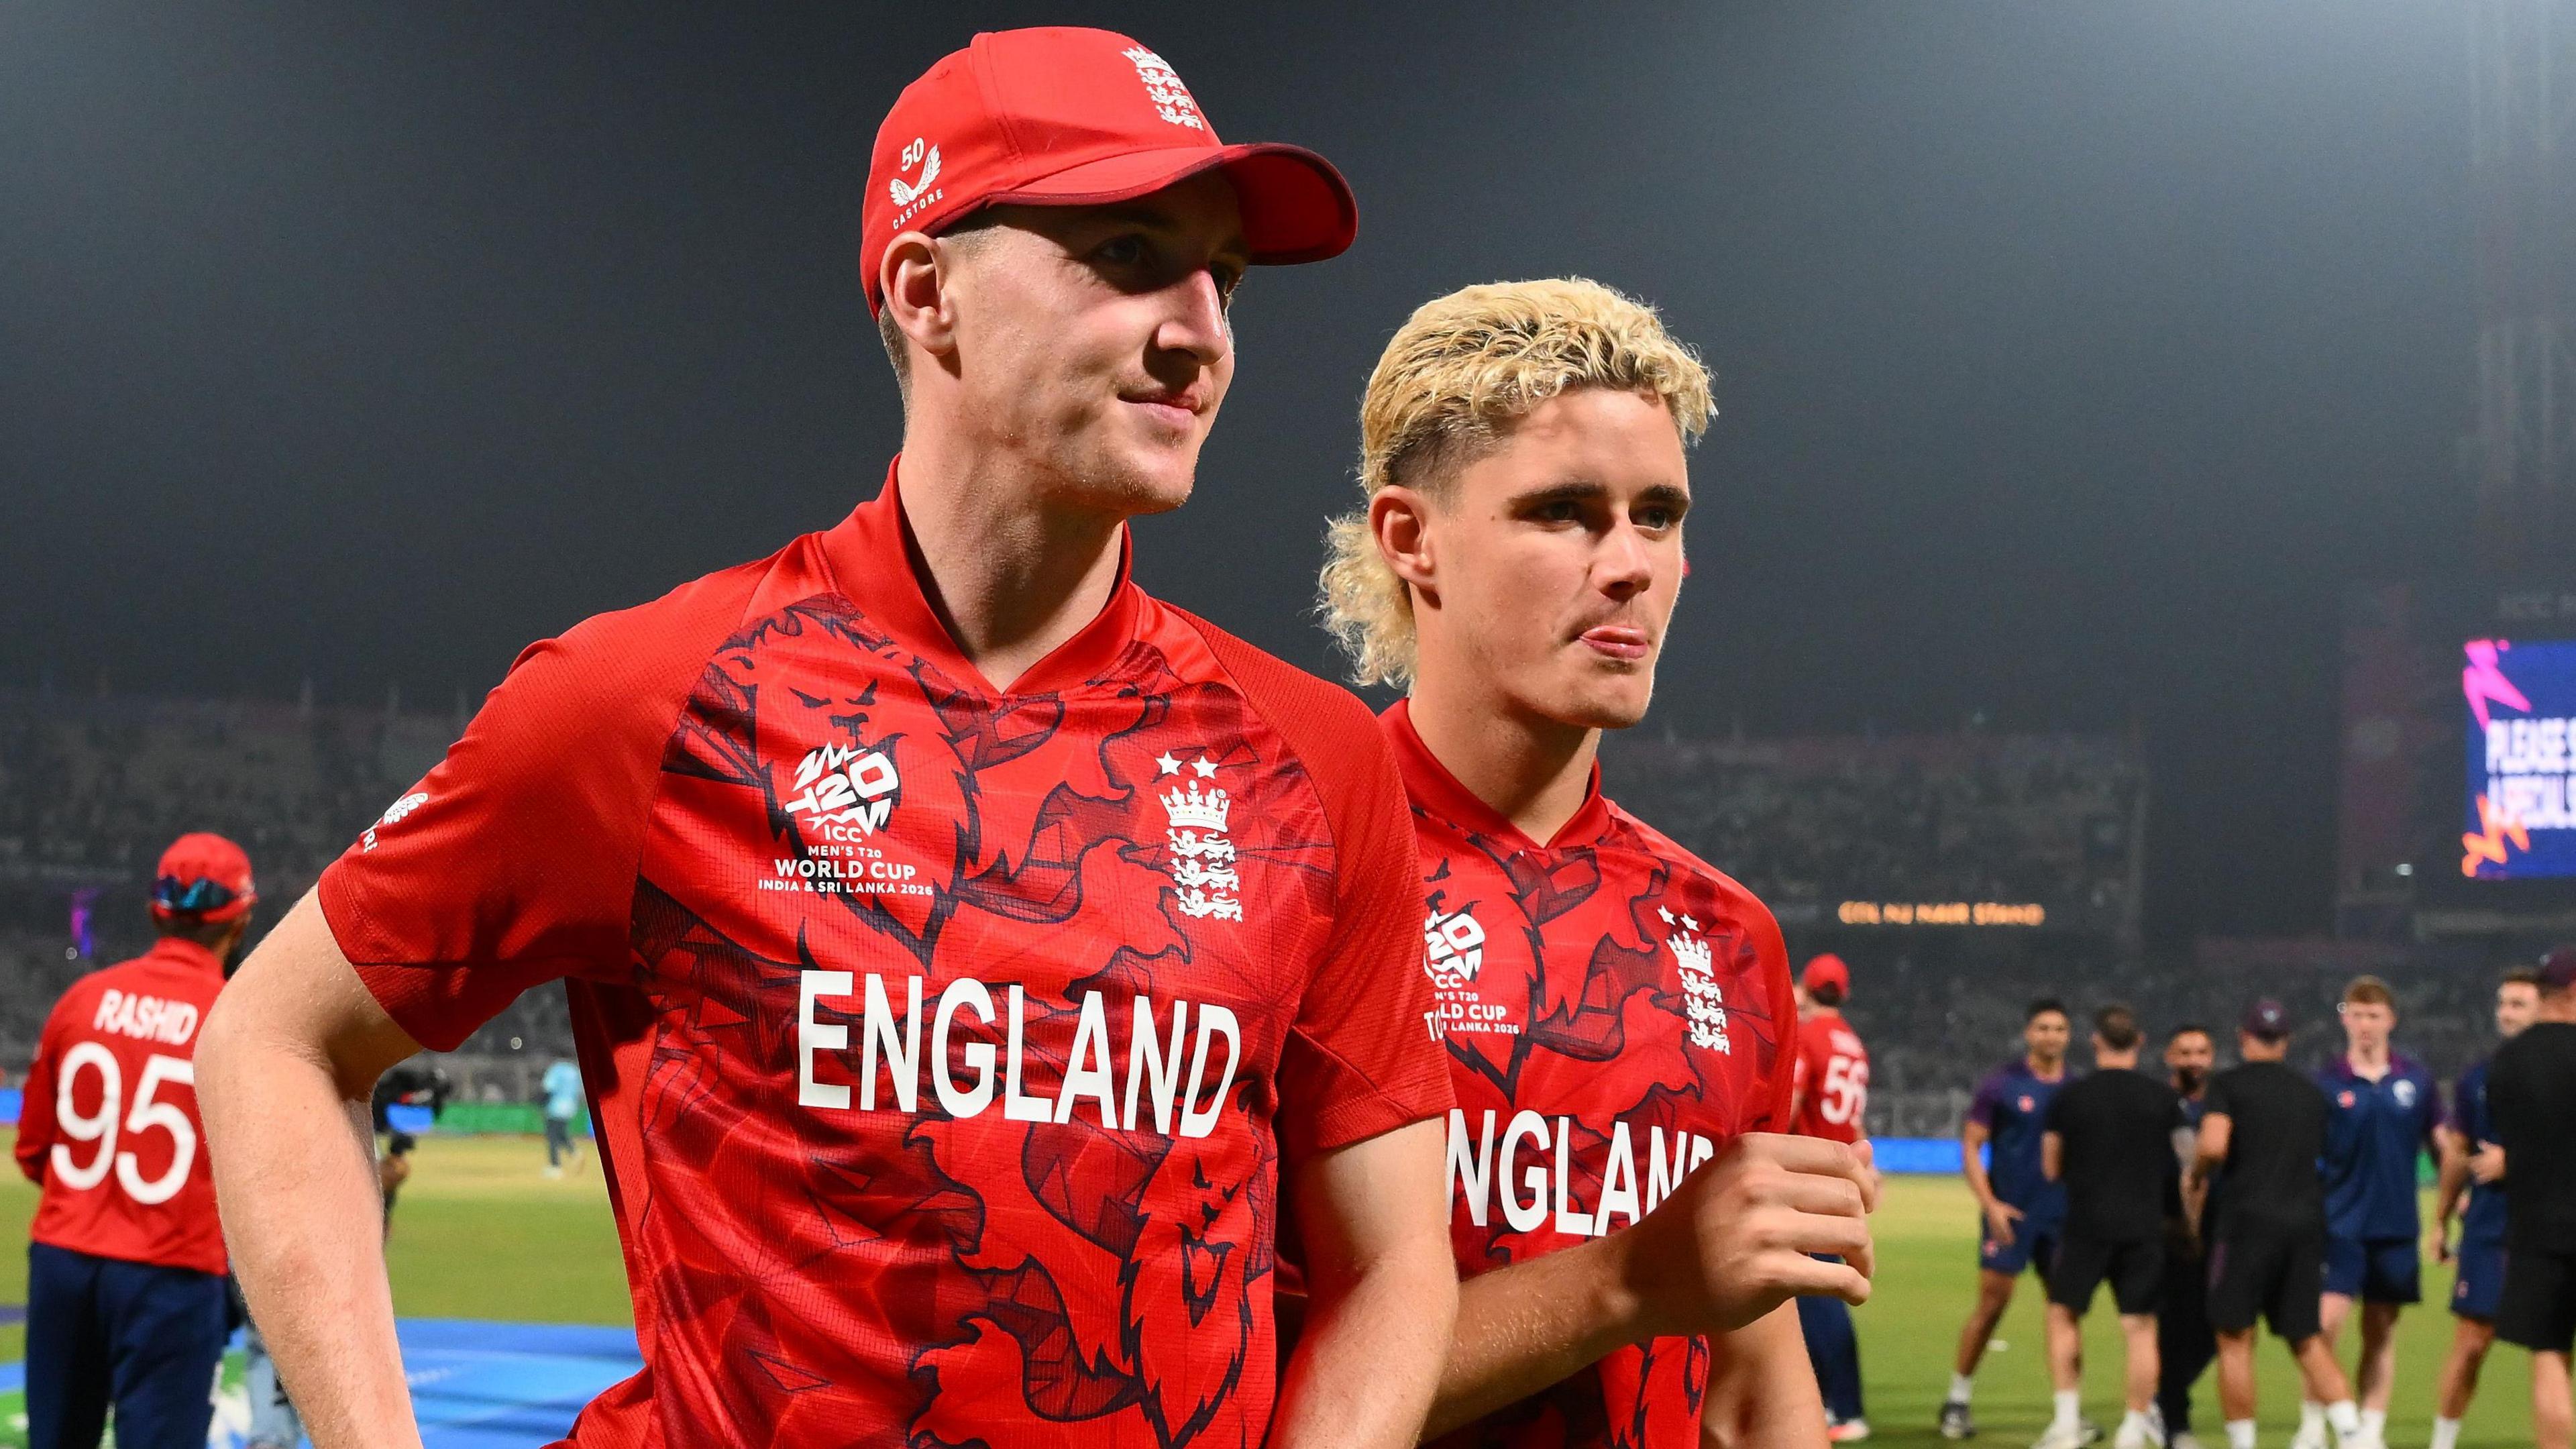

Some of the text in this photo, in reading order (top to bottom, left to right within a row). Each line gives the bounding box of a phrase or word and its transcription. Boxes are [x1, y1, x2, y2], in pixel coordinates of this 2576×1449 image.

[901, 137, 925, 172] 50
[892, 188, 944, 230] CASTORE
[824, 824, 863, 843] ICC
[808, 845, 883, 859] MEN'S T20
[774, 859, 916, 880] WORLD CUP
[758, 879, 934, 896] INDIA & SRI LANKA 2026
[1424, 913, 1486, 961] 20
[1435, 973, 1463, 989] CC
[1434, 991, 1479, 1002] N'S T20
[93, 989, 199, 1046] RASHID
[1468, 1004, 1507, 1020] CUP
[1450, 1021, 1491, 1032] LANKA
[1493, 1023, 1520, 1034] 2026
[798, 969, 1242, 1138] ENGLAND
[51, 1040, 197, 1204] 95
[1446, 1108, 1713, 1236] NGLAN
